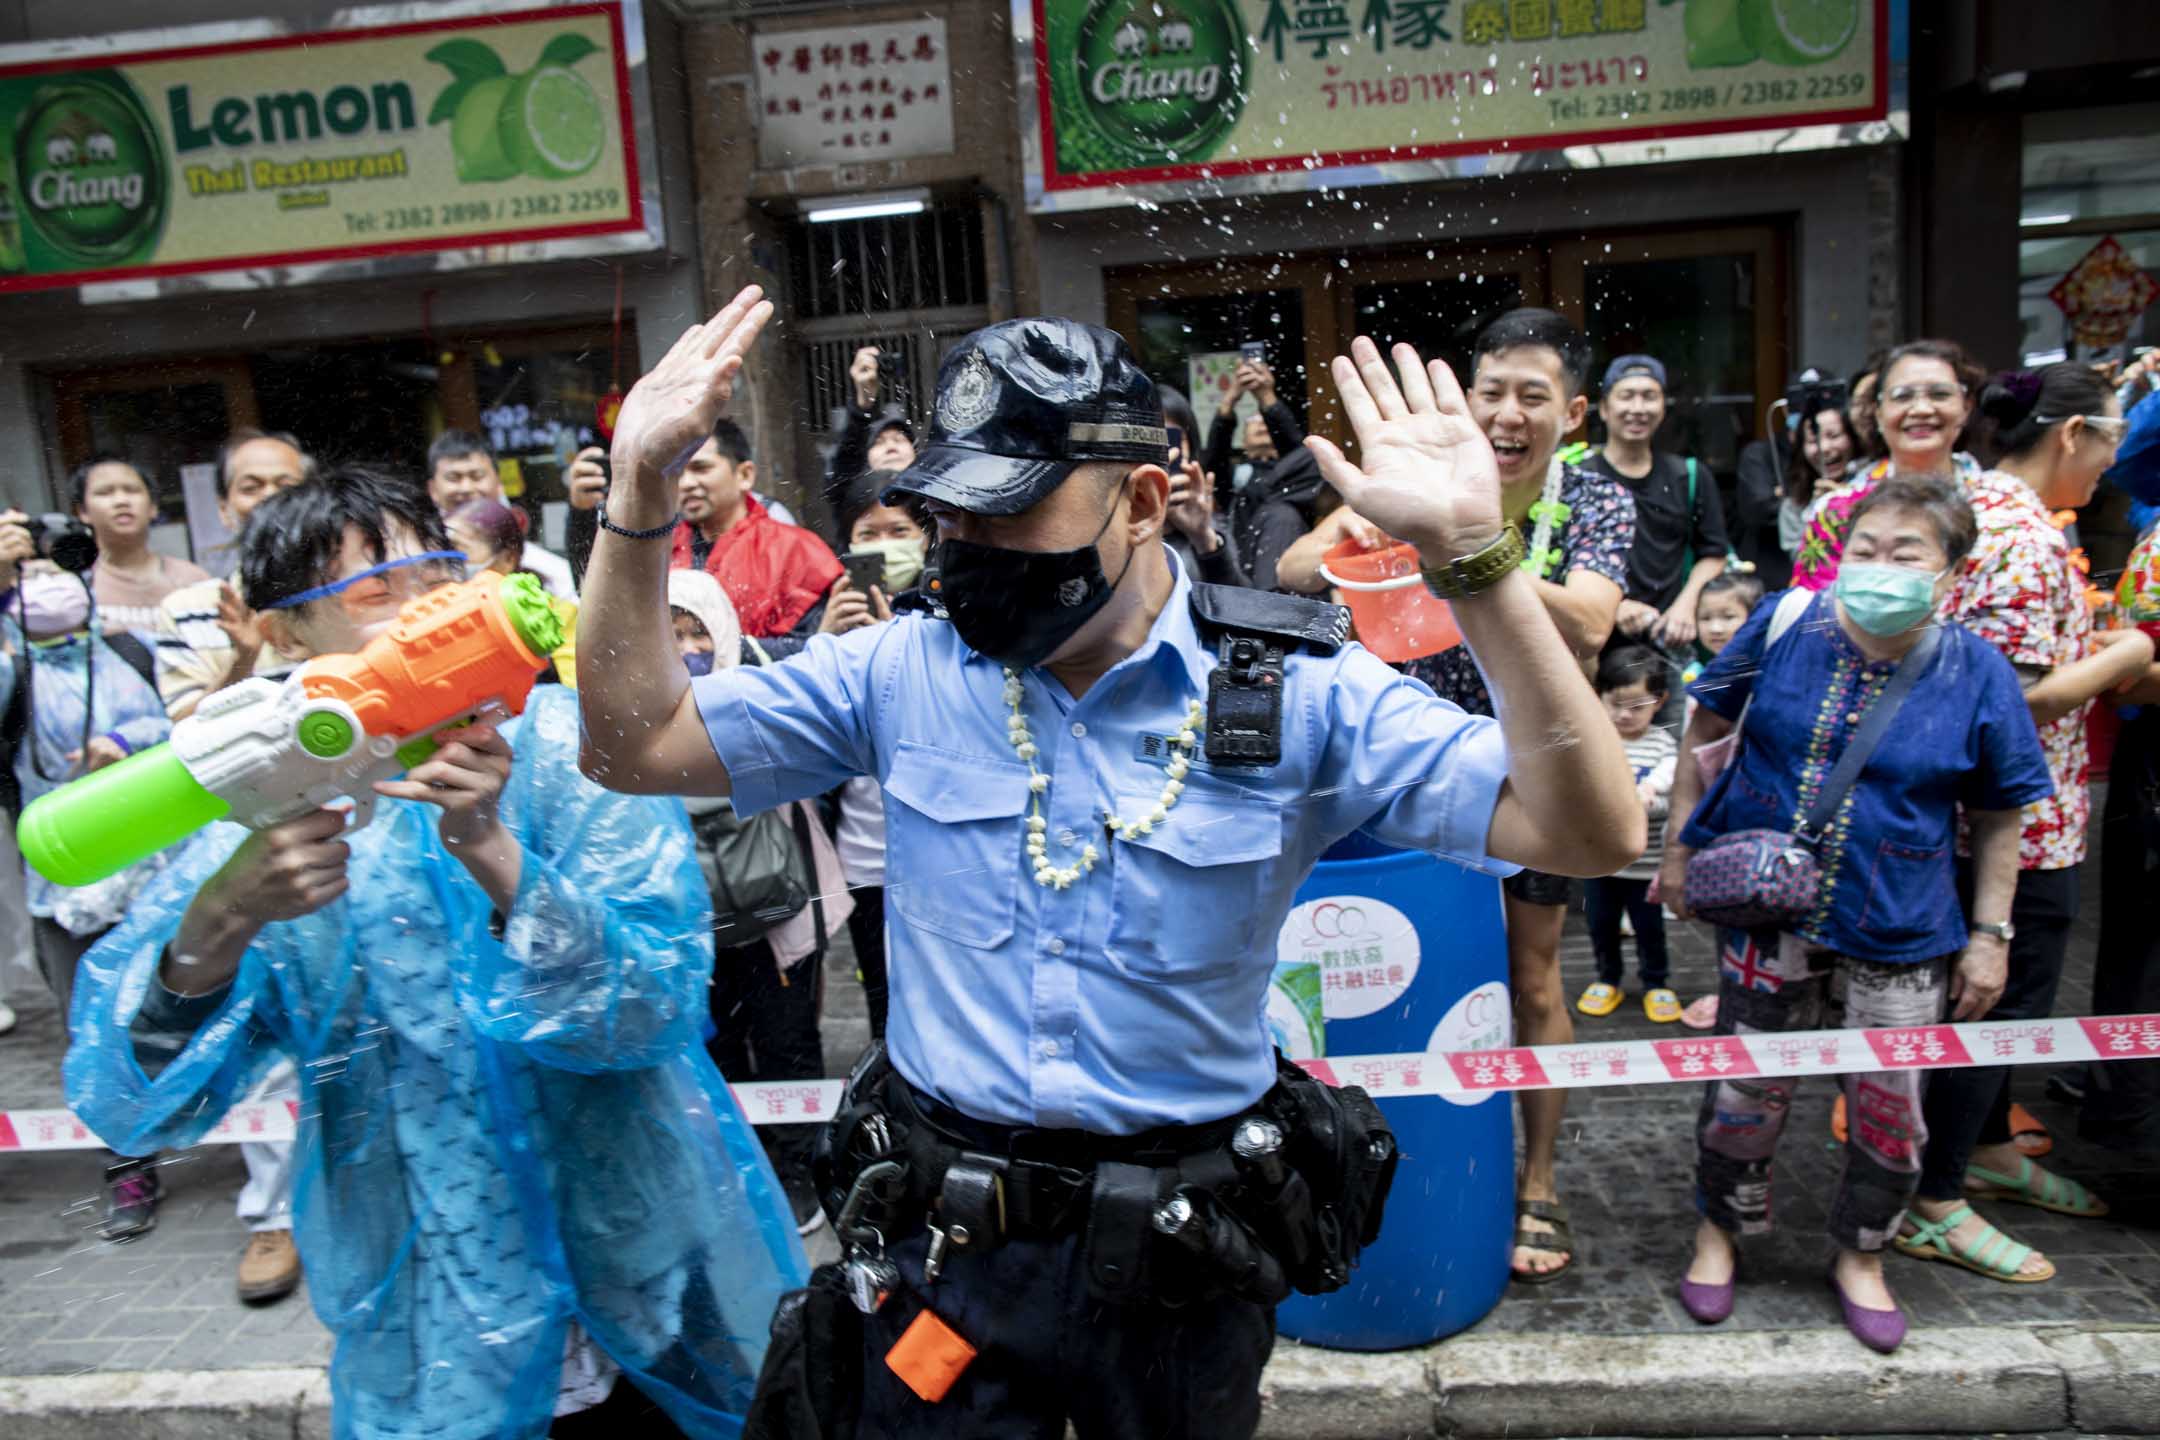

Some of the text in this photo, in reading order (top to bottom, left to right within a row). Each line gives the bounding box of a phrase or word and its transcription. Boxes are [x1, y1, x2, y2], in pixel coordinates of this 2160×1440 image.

[1091, 60, 1221, 104] Chang
[1320, 53, 1650, 110] ร้านอาหาร มะนาว
[1550, 98, 1587, 120] Tel:
[1594, 92, 1650, 117] 2382
[1660, 88, 1715, 111] 2898
[1740, 79, 1799, 105] 2382
[1806, 73, 1865, 99] 2259
[166, 80, 416, 154] Lemon
[30, 170, 144, 210] Chang
[185, 148, 408, 195] Thai Restaurant
[344, 212, 376, 233] Tel:
[384, 205, 433, 230] 2382
[441, 200, 491, 226] 2898
[512, 194, 562, 219] 2382
[568, 188, 620, 212] 2259
